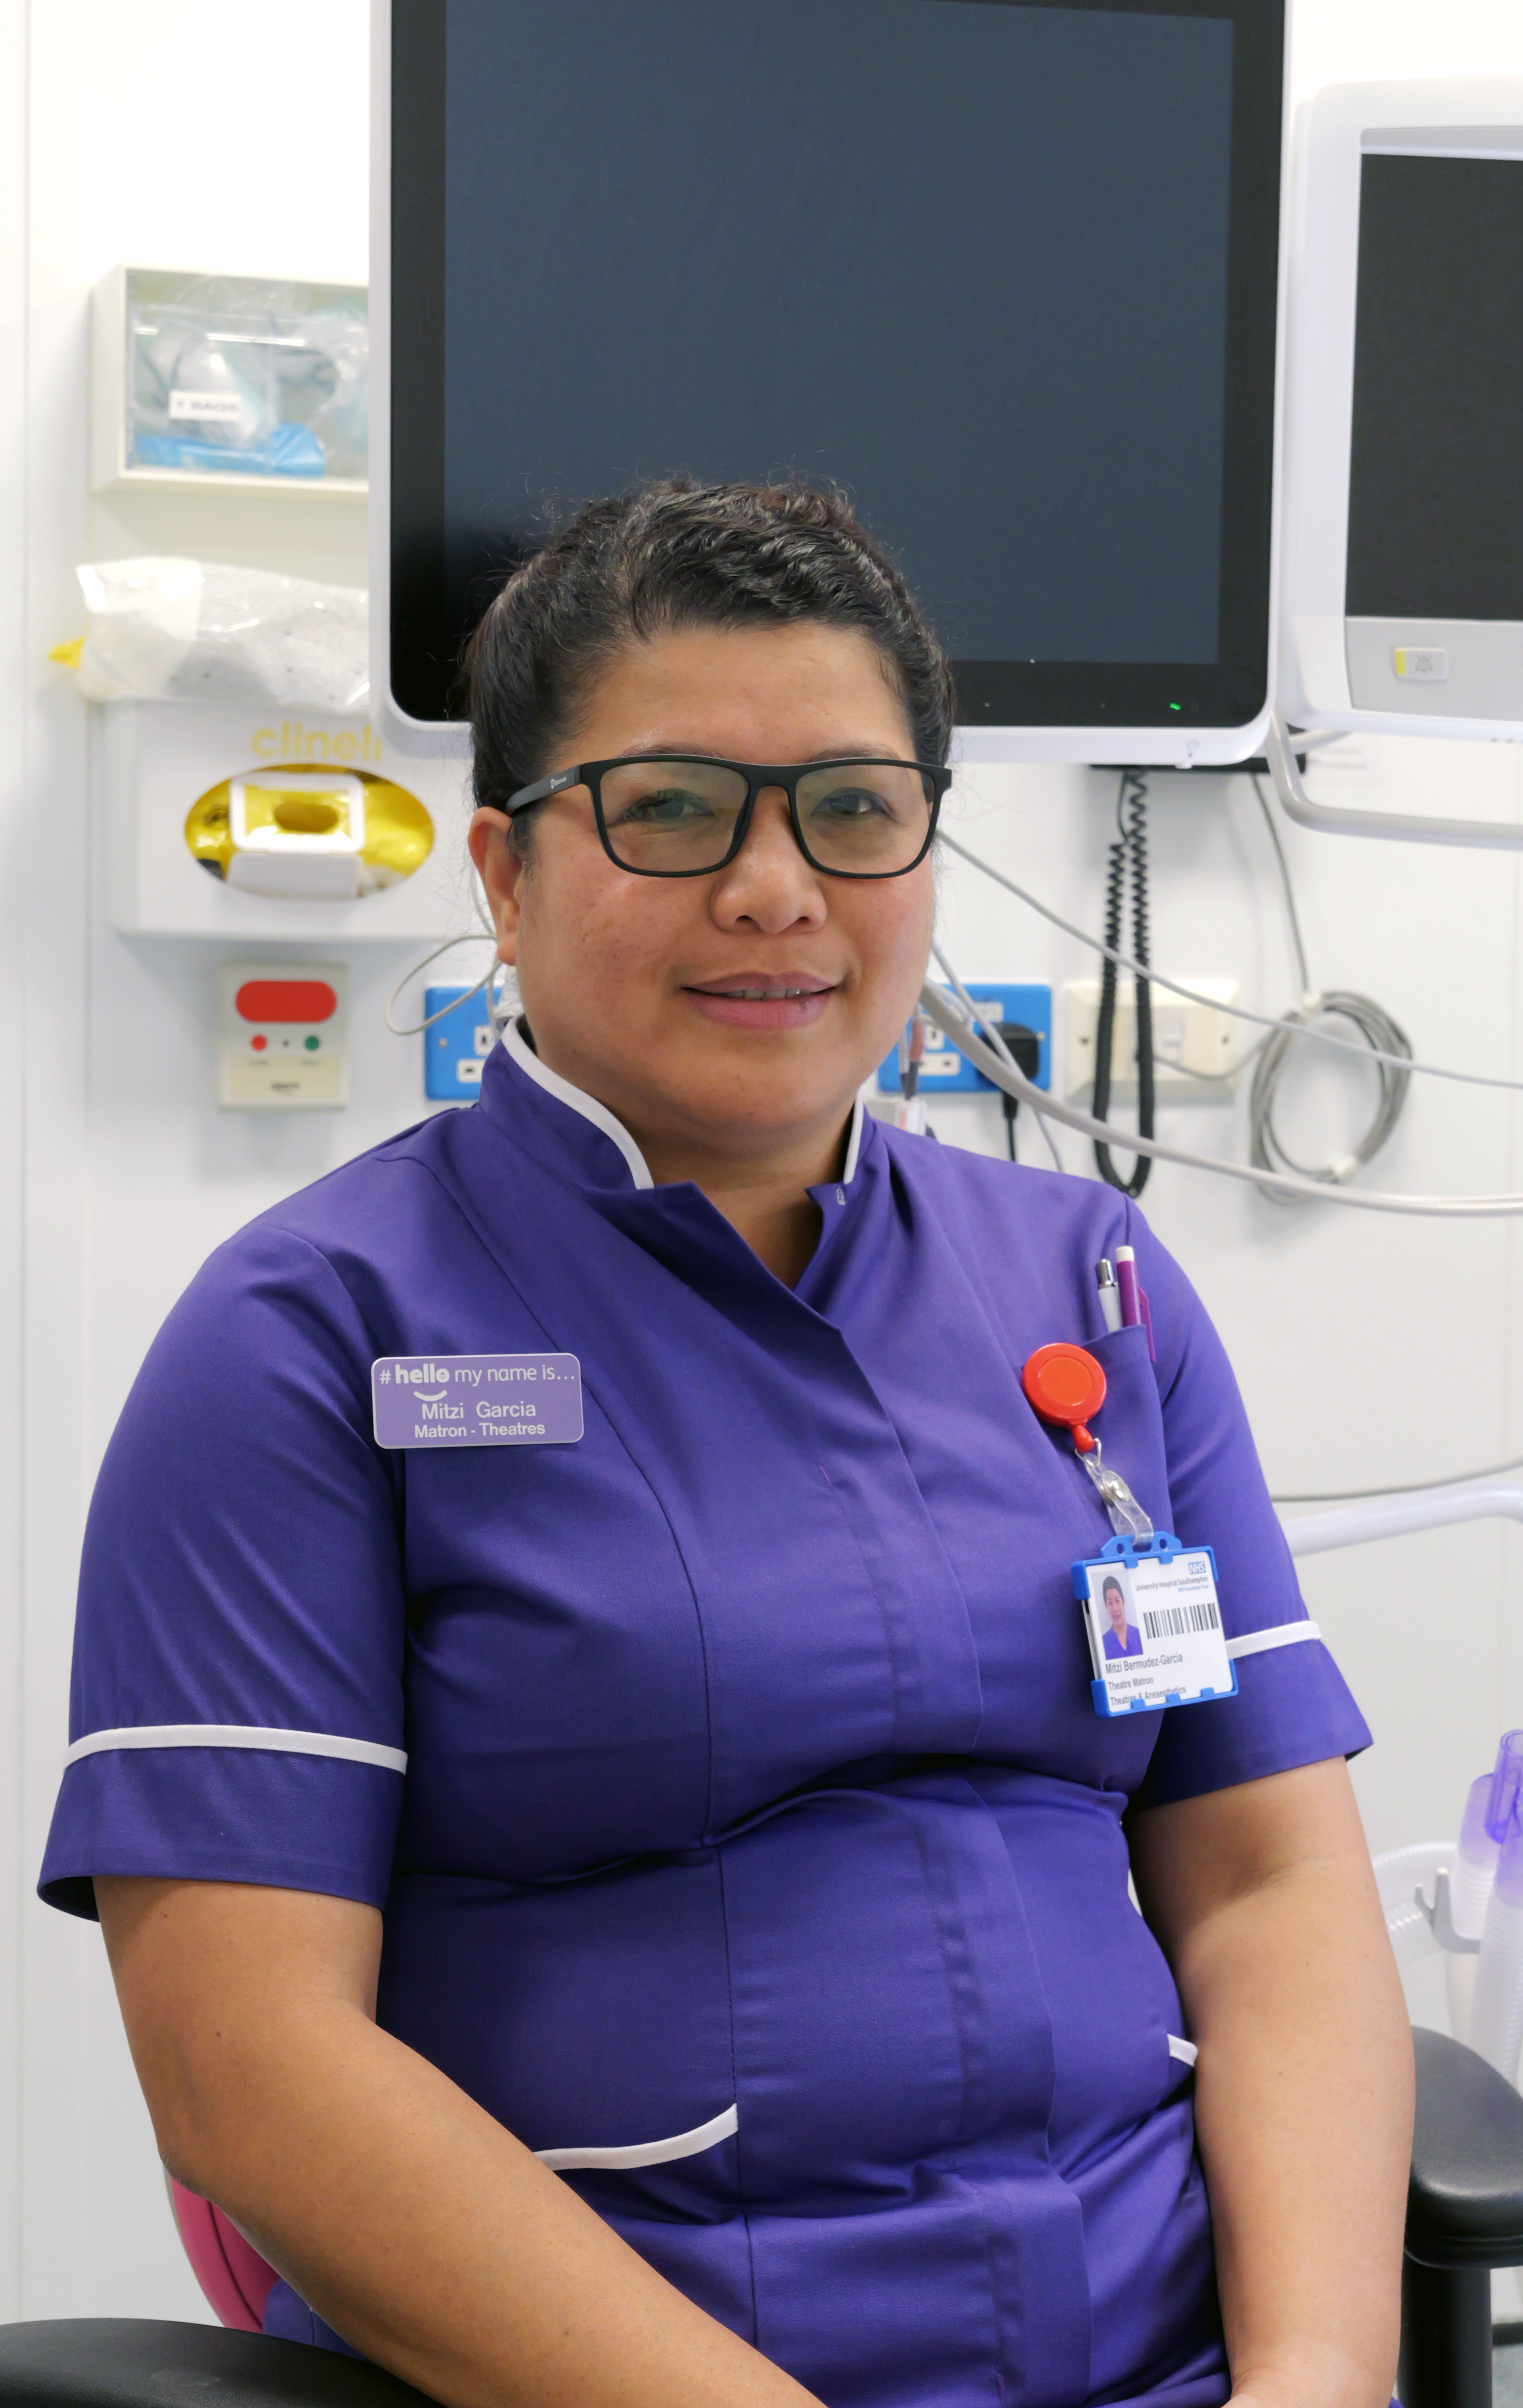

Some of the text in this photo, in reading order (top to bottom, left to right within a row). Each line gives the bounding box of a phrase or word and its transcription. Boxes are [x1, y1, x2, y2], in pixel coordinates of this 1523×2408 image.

[455, 1369, 482, 1387] my
[487, 1367, 537, 1382] name
[422, 1400, 536, 1420] Mitzi Garcia
[414, 1424, 467, 1438] Matron
[479, 1422, 545, 1436] Theatres
[1189, 1562, 1206, 1574] NHS
[1135, 1576, 1208, 1591] University Hospital Southampton
[1105, 1653, 1183, 1674] Mitzi Bermudez-Garcia
[1108, 1677, 1154, 1691] Theatre Matron
